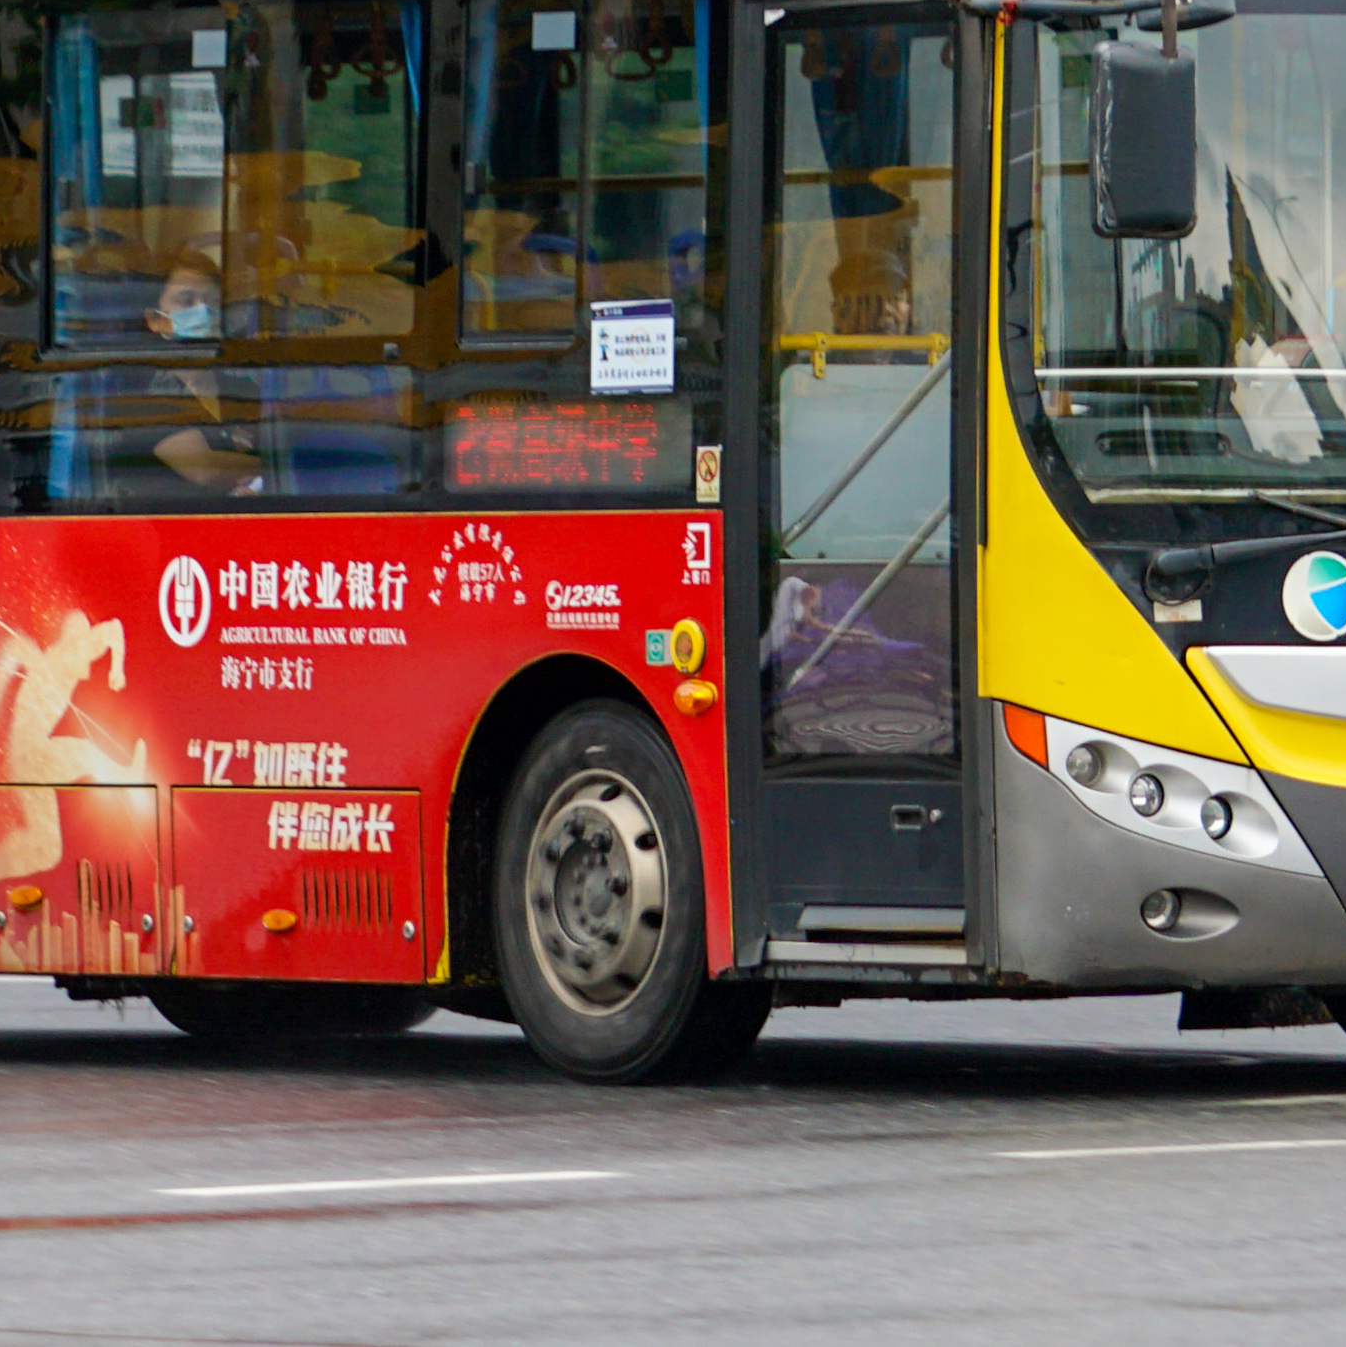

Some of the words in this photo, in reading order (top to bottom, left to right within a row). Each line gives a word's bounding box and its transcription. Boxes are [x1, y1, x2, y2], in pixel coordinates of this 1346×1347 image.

[218, 559, 409, 612] 中国农业银行
[220, 626, 310, 645] AGRICULTURAL
[313, 627, 348, 645] BANK
[349, 627, 367, 645] OF
[369, 627, 408, 646] CHINA
[220, 655, 314, 691] 海宁市支行
[267, 800, 394, 853] 伴您成长
